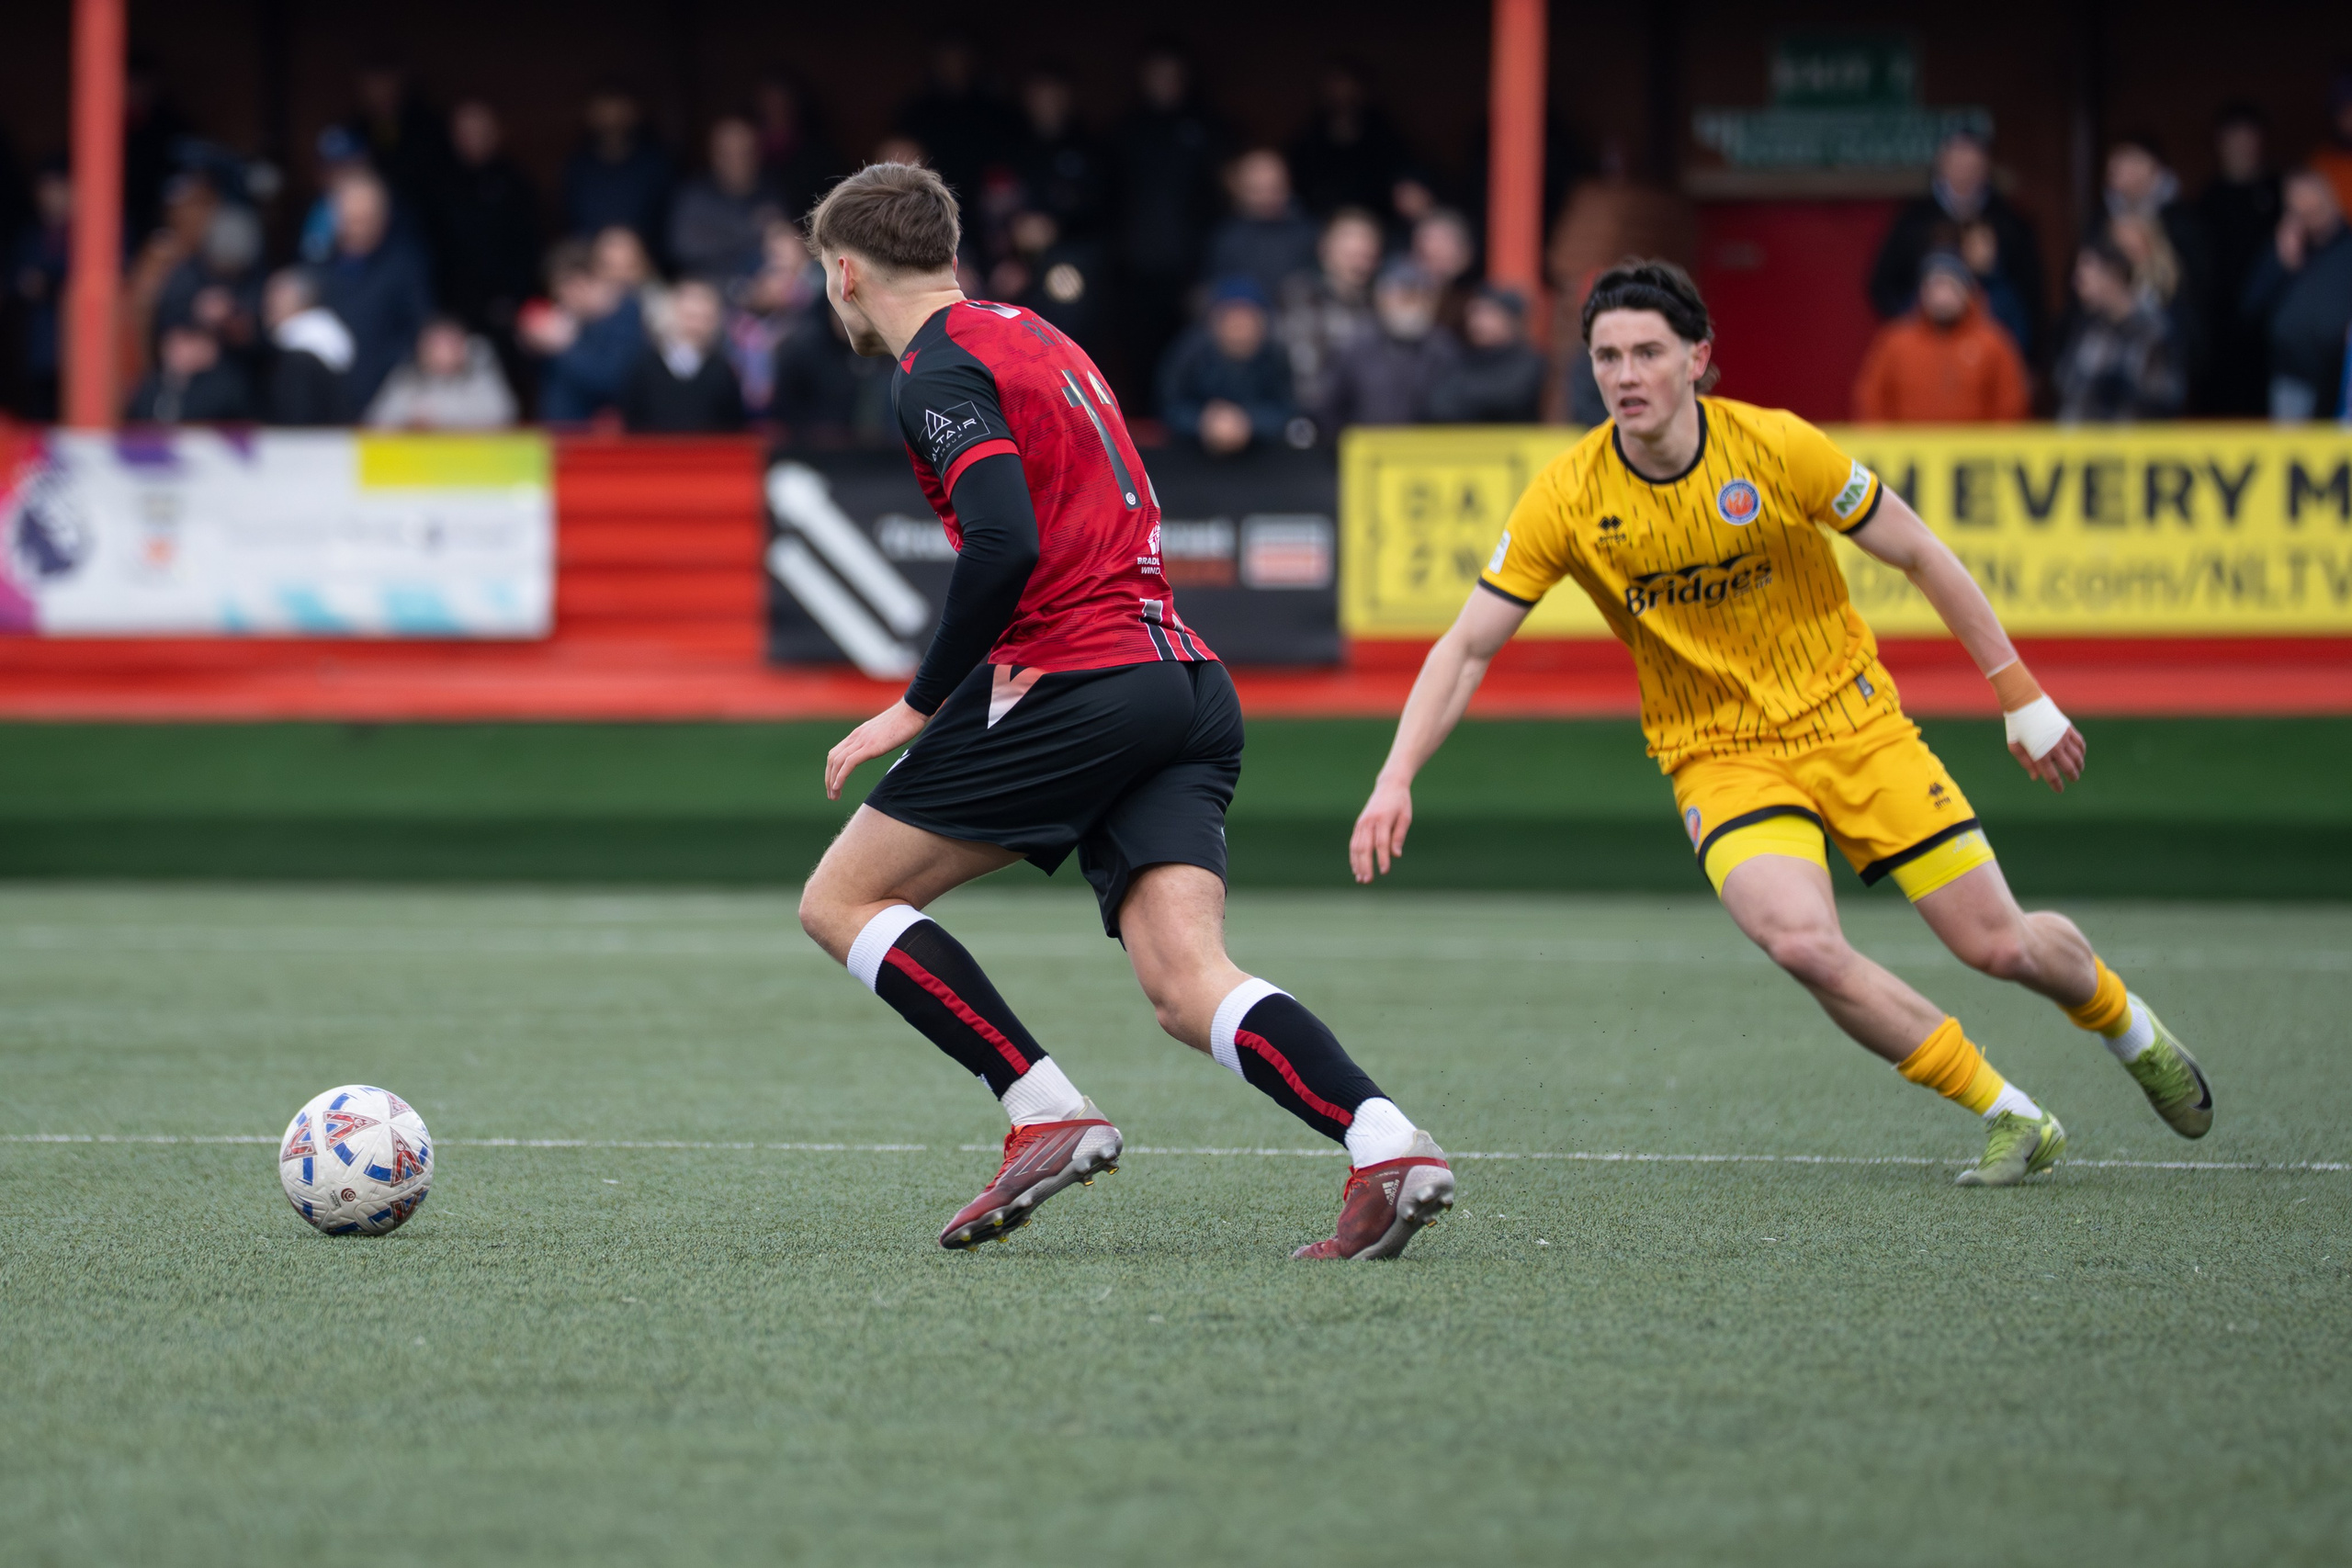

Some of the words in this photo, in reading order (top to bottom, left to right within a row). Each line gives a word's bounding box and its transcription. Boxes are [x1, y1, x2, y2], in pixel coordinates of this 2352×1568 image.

[932, 417, 978, 462] ALTAIR
[1951, 459, 2257, 527] EVERY
[1625, 558, 1773, 617] Bridges
